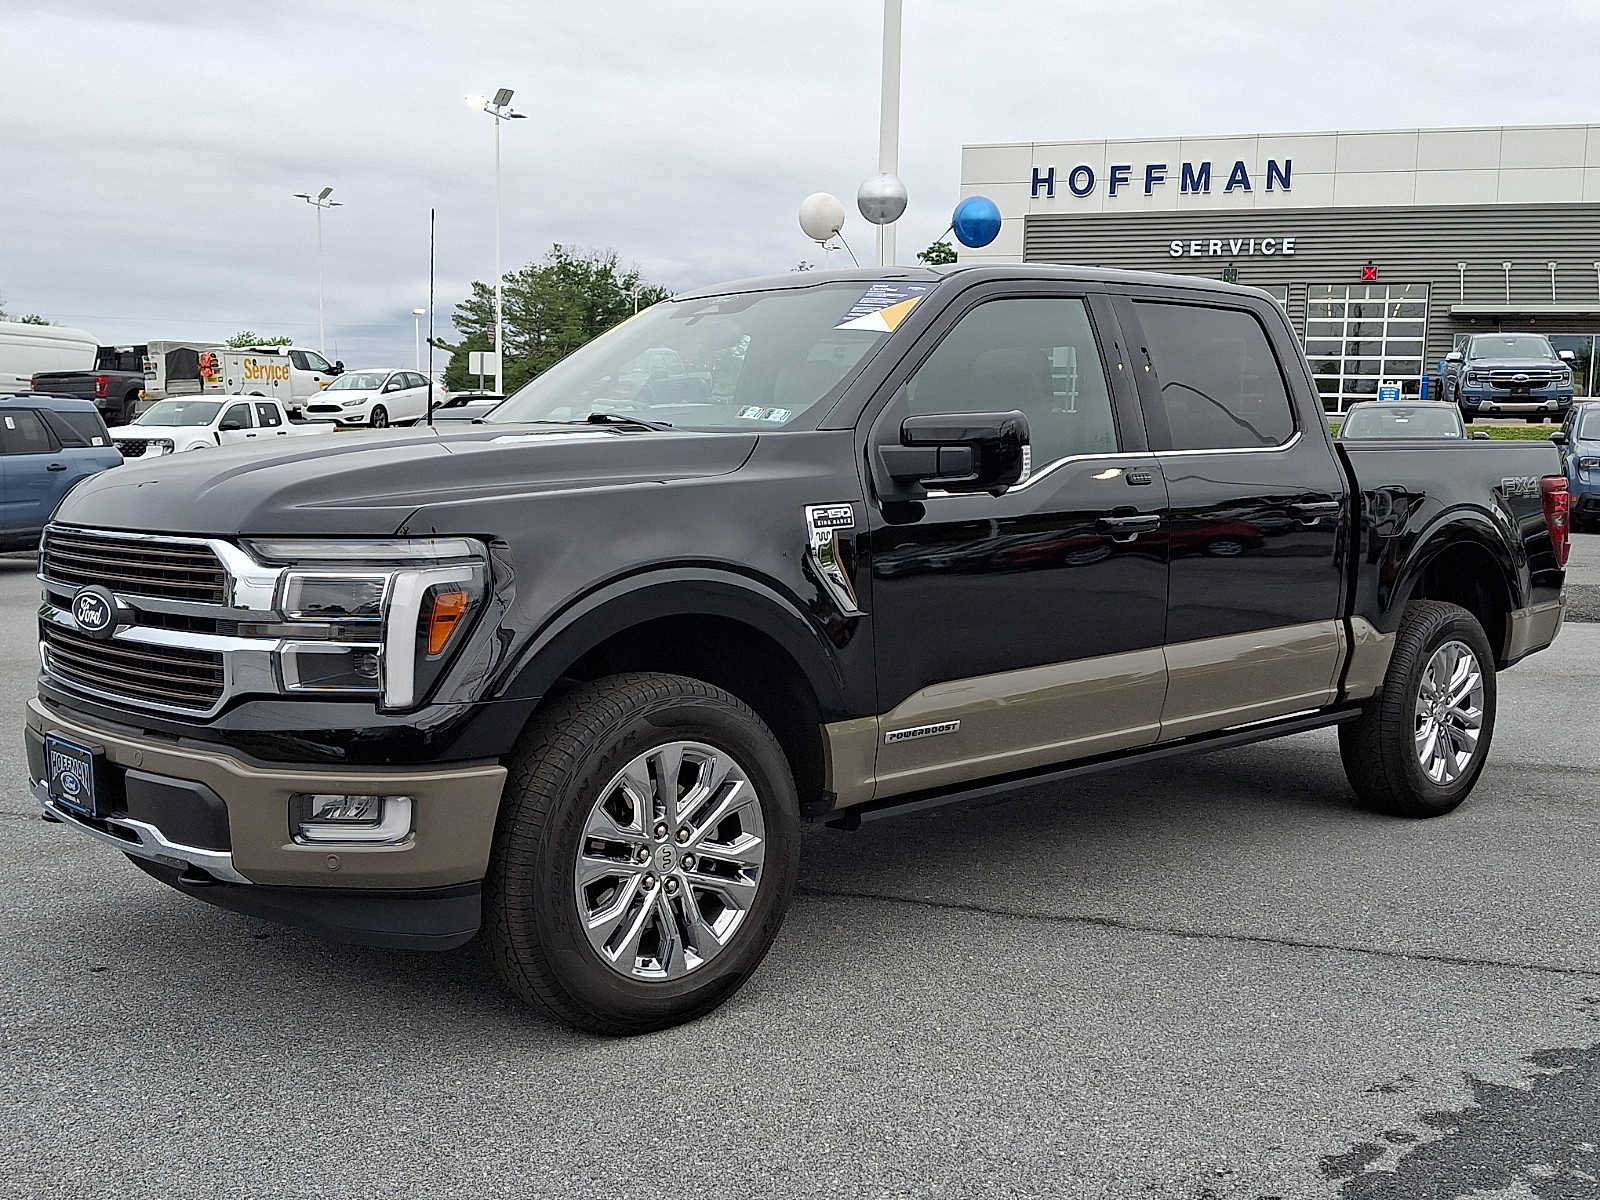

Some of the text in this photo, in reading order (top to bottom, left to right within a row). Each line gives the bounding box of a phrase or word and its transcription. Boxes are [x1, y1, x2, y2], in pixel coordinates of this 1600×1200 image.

[1030, 159, 1293, 198] HOFFMAN
[1169, 238, 1297, 258] SERVICE
[243, 358, 289, 380] Service
[1501, 476, 1538, 498] FX4
[813, 508, 852, 519] F-150
[78, 596, 103, 625] Ford
[889, 723, 958, 740] POWERBOOST
[50, 751, 91, 798] HOFFMAN
